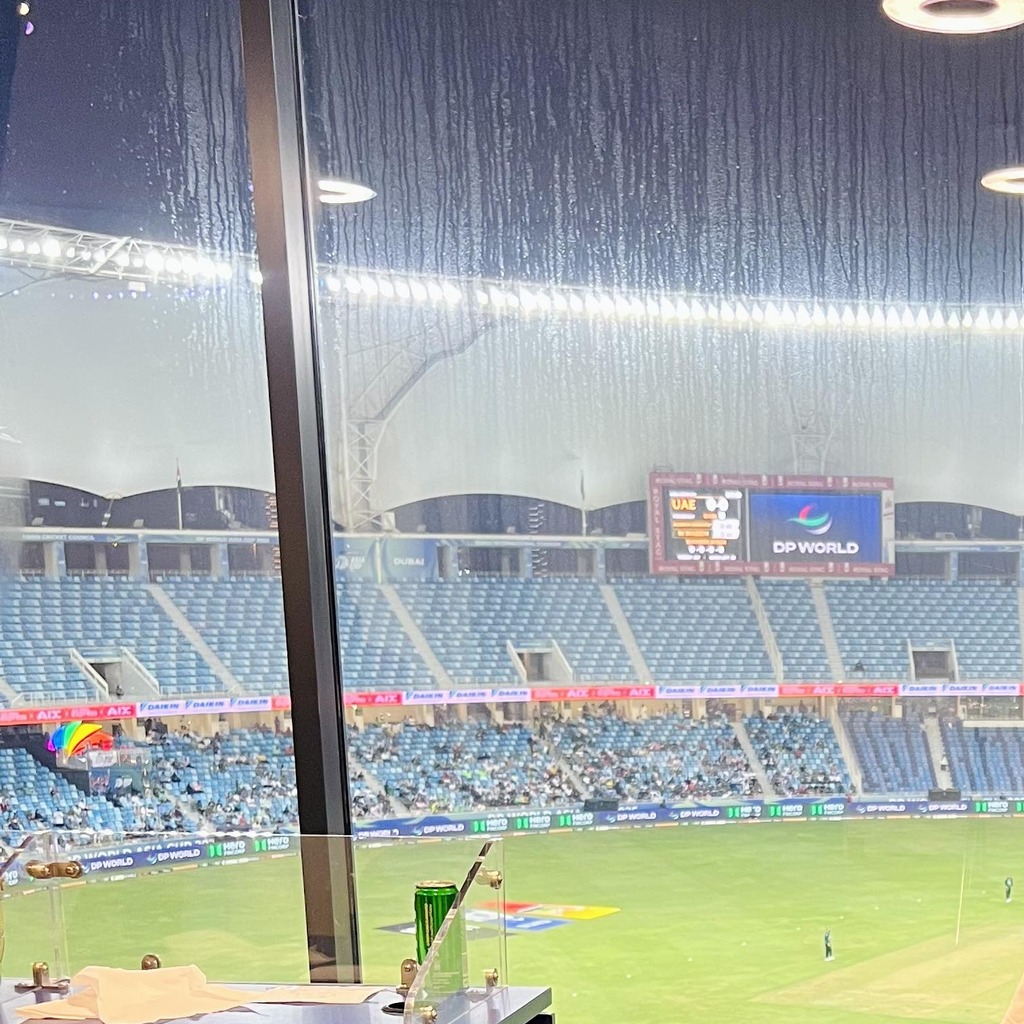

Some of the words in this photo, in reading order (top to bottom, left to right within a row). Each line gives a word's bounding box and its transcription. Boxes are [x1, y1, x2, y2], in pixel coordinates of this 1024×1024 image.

[671, 498, 697, 511] UAE
[773, 542, 796, 554] DP
[798, 542, 859, 554] WORLD
[424, 826, 434, 834] DP
[434, 824, 464, 834] WORLD
[158, 852, 170, 862] DP
[169, 849, 200, 860] WORLD
[90, 862, 102, 870] DP
[102, 857, 134, 869] WORLD
